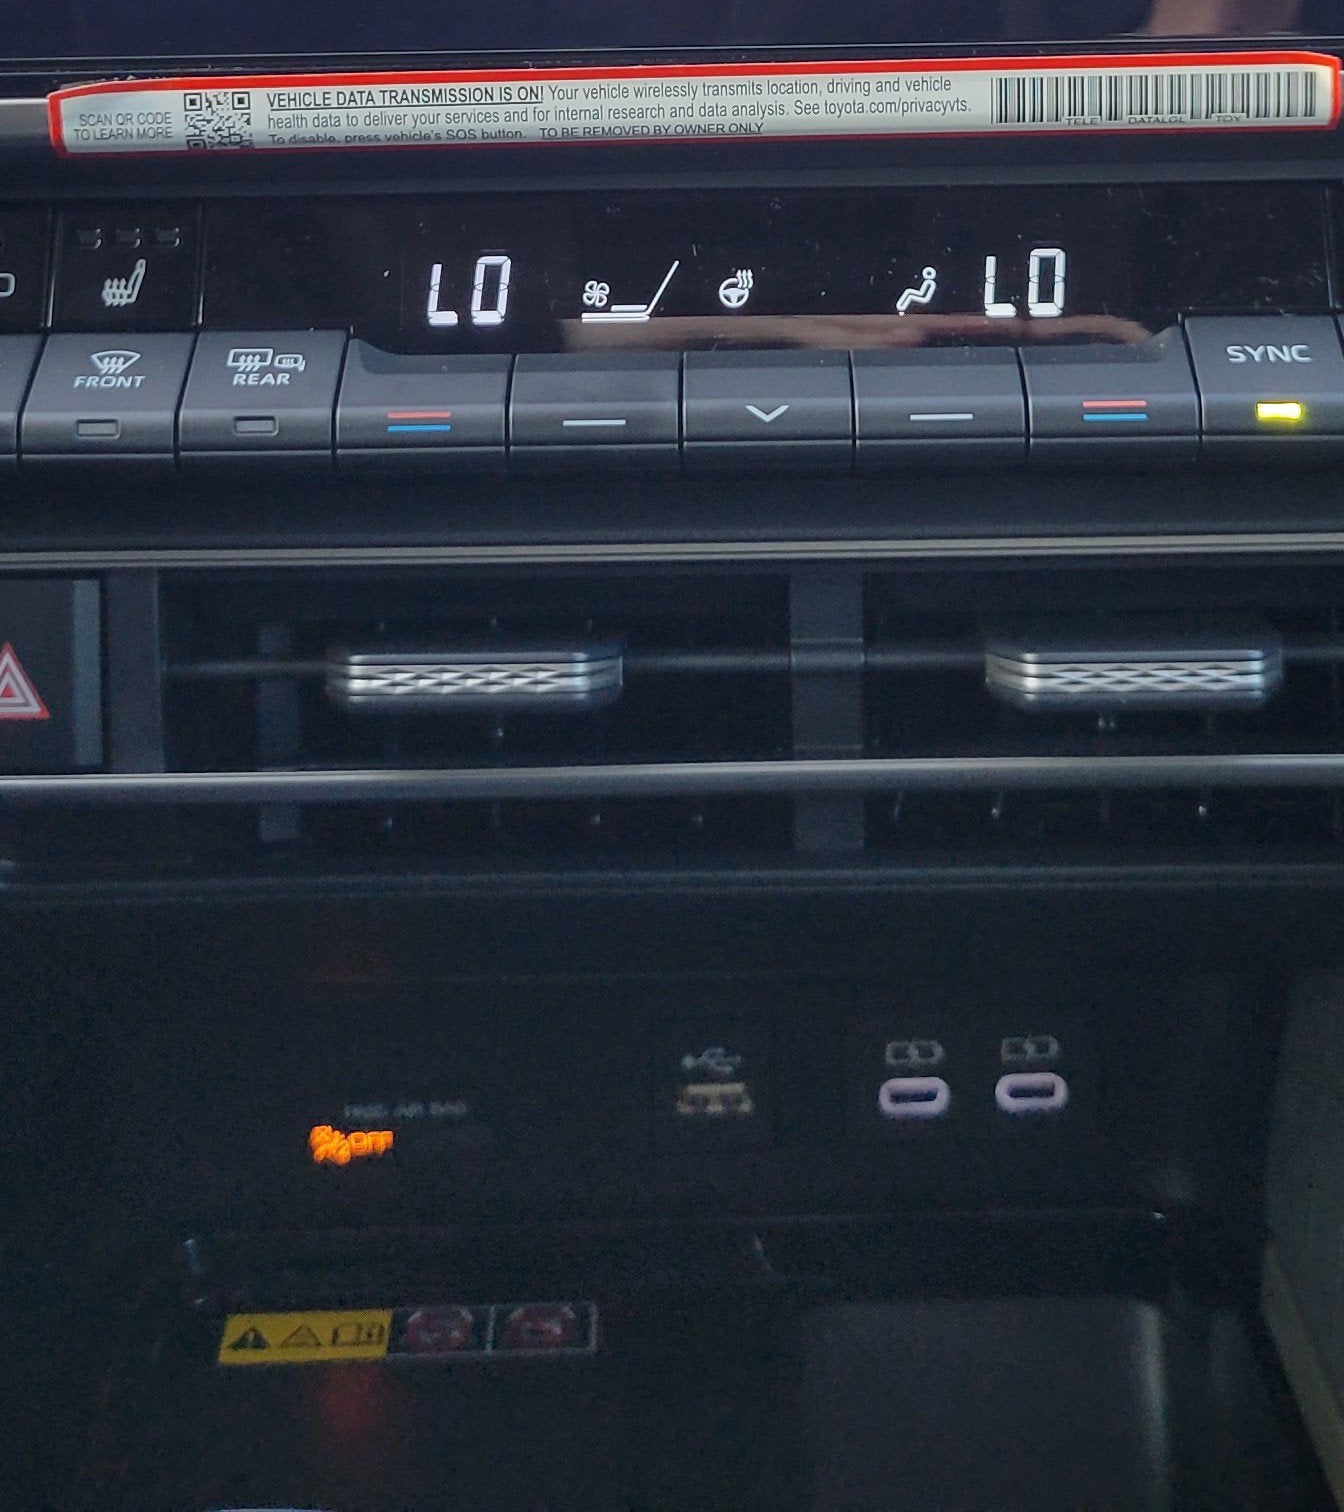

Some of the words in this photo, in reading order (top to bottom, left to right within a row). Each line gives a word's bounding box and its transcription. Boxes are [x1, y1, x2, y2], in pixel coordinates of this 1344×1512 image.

[267, 91, 332, 108] VEHICLE
[336, 90, 376, 106] DATA
[379, 87, 494, 105] TRANSMISSION
[499, 86, 513, 101] IS
[517, 86, 543, 101] ON!
[549, 85, 579, 100] Your
[583, 83, 629, 99] vehicle
[633, 82, 698, 100] wirelessly
[702, 79, 763, 96] transmits
[767, 78, 822, 96] location,
[827, 78, 870, 96] driving
[875, 77, 900, 92] and
[905, 76, 951, 92] vehicle
[79, 113, 113, 127] SCAN
[116, 112, 132, 126] QR
[137, 112, 172, 126] CODE
[268, 114, 307, 129] health
[312, 113, 341, 128] data
[346, 114, 358, 127] to
[364, 111, 407, 126] deliver
[412, 112, 440, 128] your
[445, 109, 500, 125] services
[504, 107, 528, 122] and
[532, 107, 550, 121] for
[554, 105, 603, 121] internal
[608, 104, 665, 120] research
[670, 103, 694, 118] and
[698, 101, 727, 117] data
[732, 100, 789, 119] analysis.
[794, 99, 820, 115] See
[74, 128, 91, 141] TO
[93, 128, 134, 140] LEARN
[137, 127, 173, 139] MORE
[269, 134, 284, 144] To
[345, 133, 382, 144] press
[384, 130, 441, 142] vehicle's
[445, 129, 476, 140] SOS
[481, 129, 526, 139] button.
[540, 127, 557, 138] TO
[561, 126, 579, 137] BE
[582, 124, 650, 136] REMOVED
[653, 124, 671, 135] BY
[674, 123, 725, 134] OWNER
[728, 122, 764, 134] ONLY
[427, 255, 511, 326] LO
[984, 247, 1066, 318] LO
[1226, 344, 1312, 365] SYNC
[74, 374, 145, 390] FRONT
[231, 372, 290, 386] REAR
